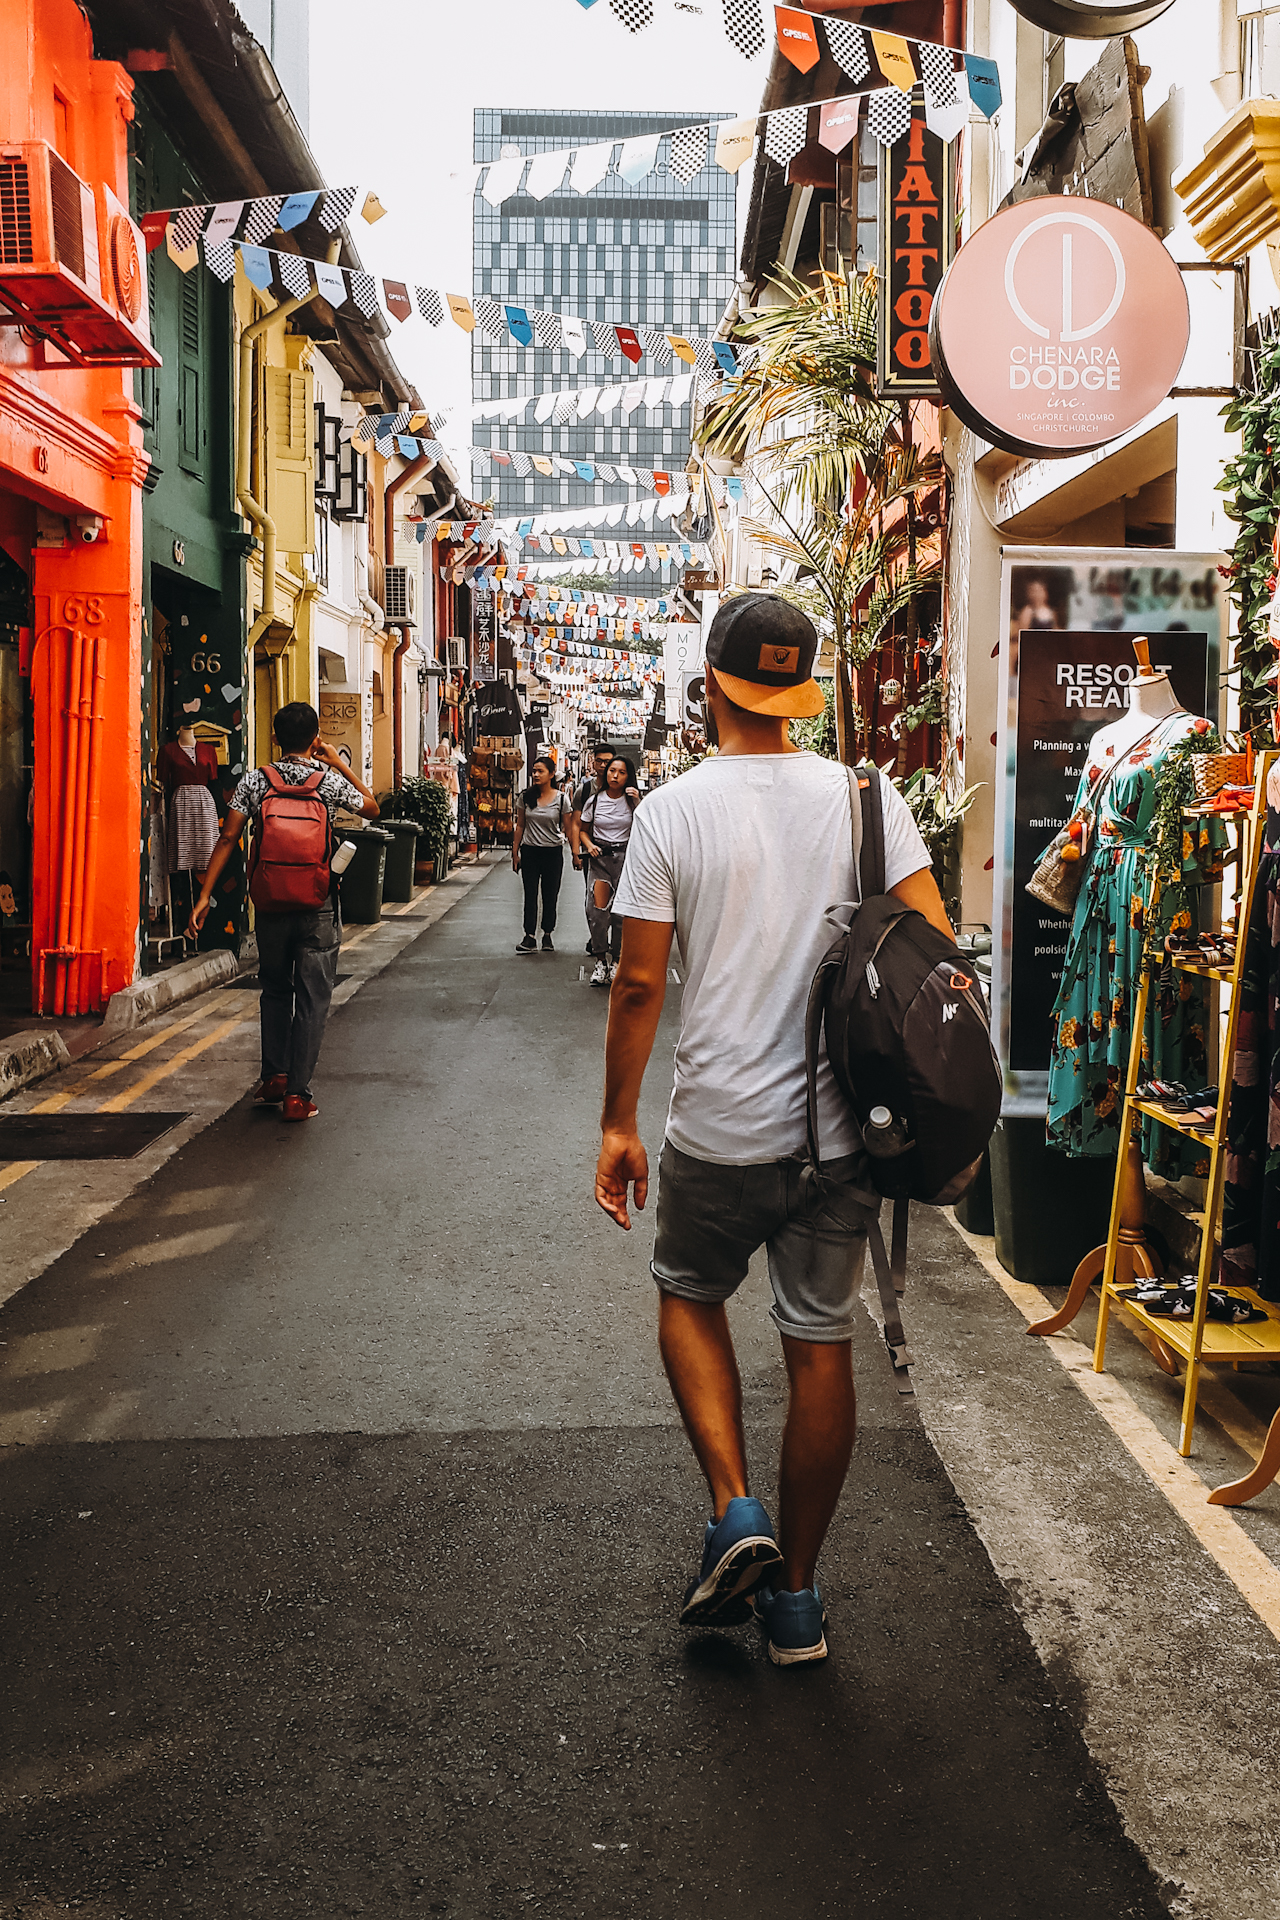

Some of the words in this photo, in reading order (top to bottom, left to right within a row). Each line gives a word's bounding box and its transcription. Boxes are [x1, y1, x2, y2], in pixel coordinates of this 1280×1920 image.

[1009, 346, 1120, 365] CHENARA
[1009, 365, 1121, 391] DODGE
[1047, 392, 1085, 408] inc.
[1017, 412, 1064, 421] SINGAPORE
[1072, 413, 1115, 421] COLOMBO
[1033, 424, 1099, 432] CHRISTCHURCH
[37, 446, 49, 473] 68
[173, 540, 185, 565] 66
[63, 596, 105, 625] 68
[191, 651, 222, 674] 66
[1056, 664, 1173, 686] RESOT
[1033, 739, 1074, 753] Planning
[1076, 742, 1082, 751] a
[1029, 817, 1069, 828] multitas
[1034, 944, 1066, 956] poolsid
